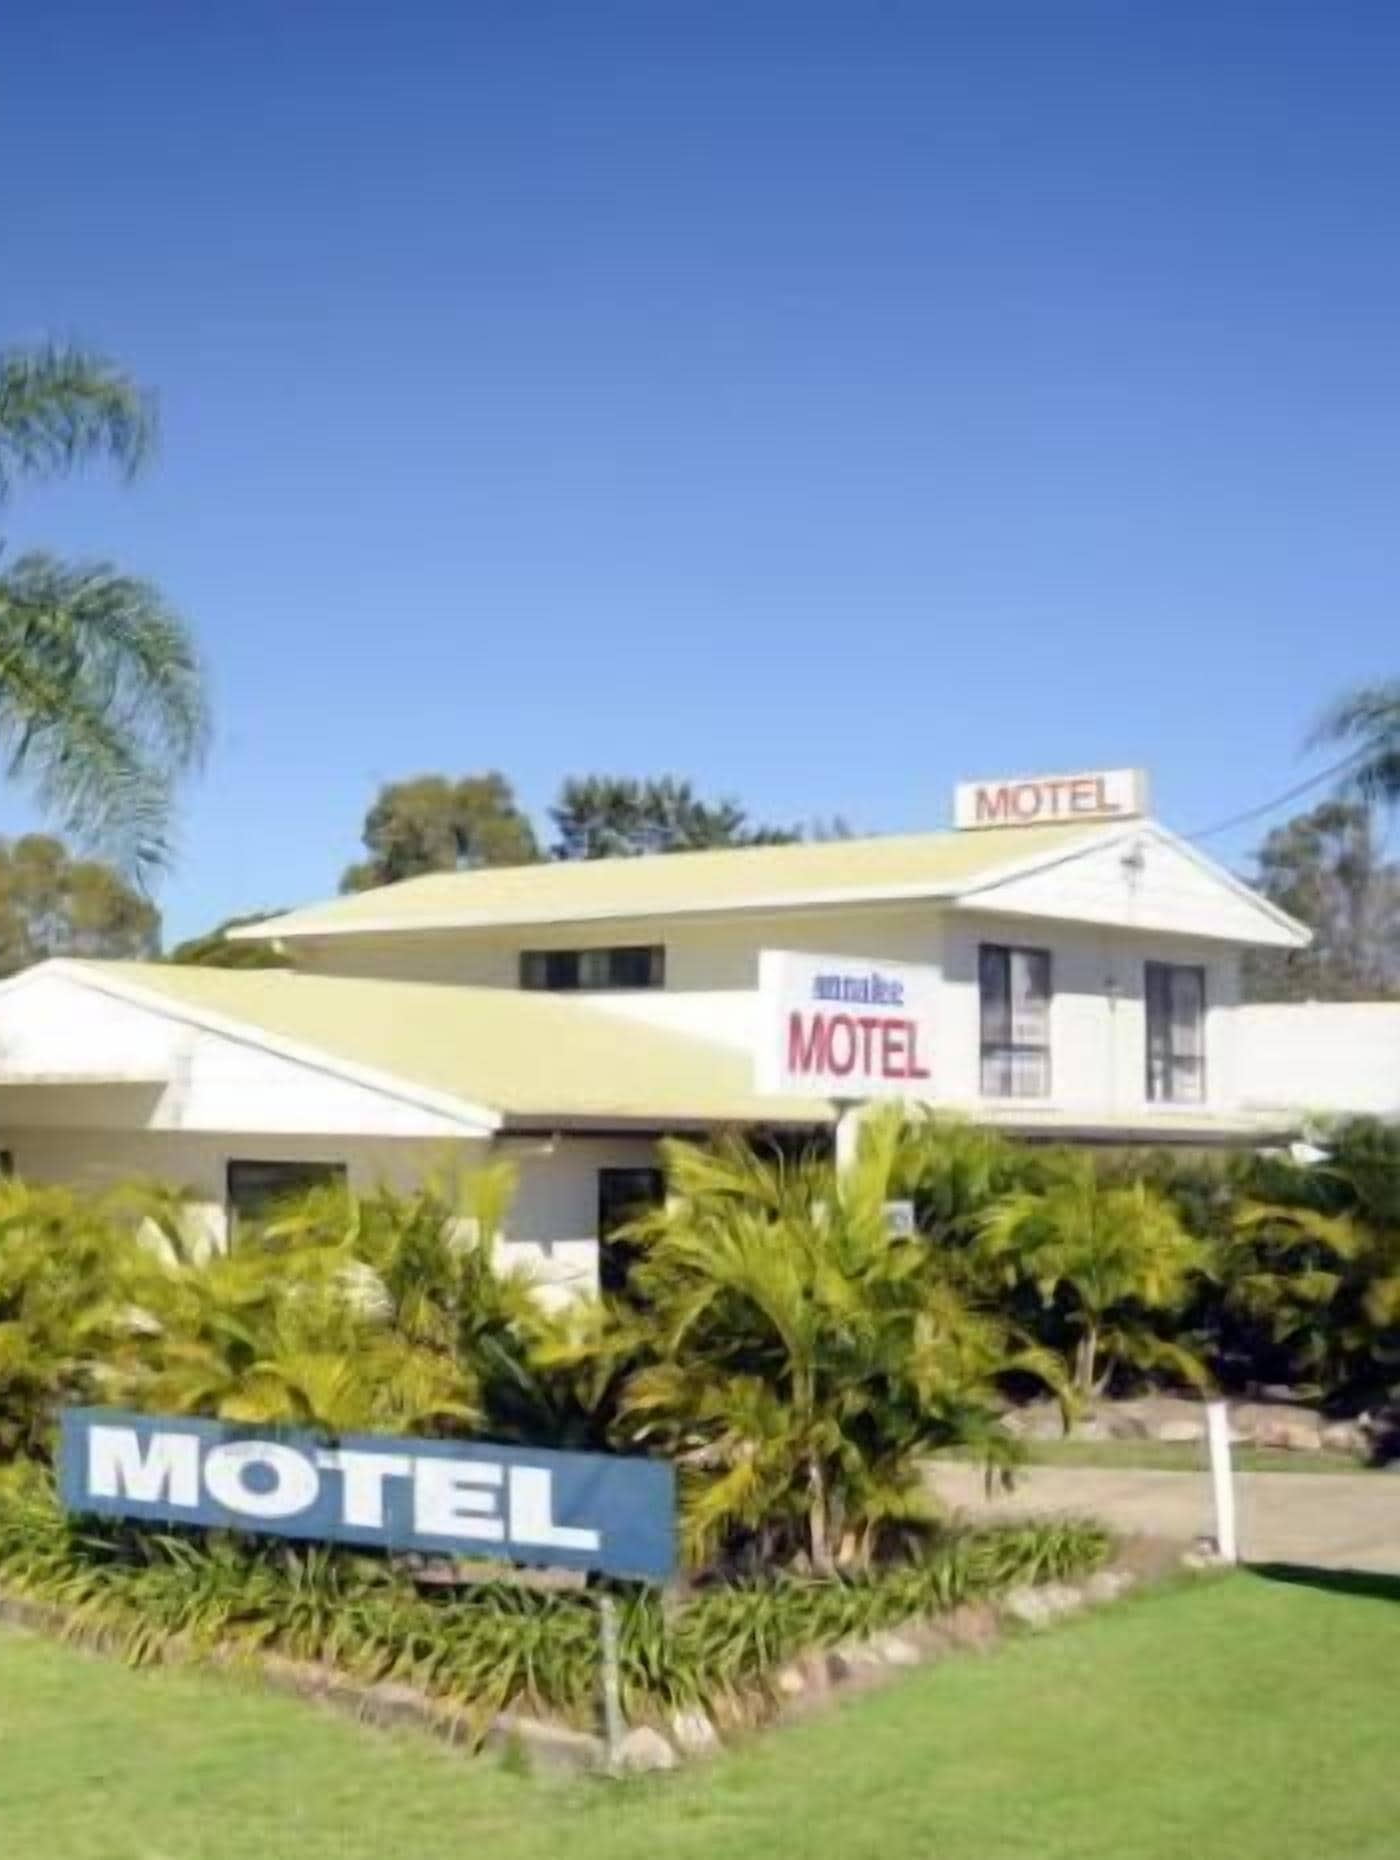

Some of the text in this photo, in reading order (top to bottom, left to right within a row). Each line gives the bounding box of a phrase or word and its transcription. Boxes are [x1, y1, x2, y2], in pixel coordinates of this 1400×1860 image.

[975, 776, 1121, 820] MOTEL
[787, 1011, 931, 1079] MOTEL
[87, 1425, 599, 1551] MOTEL
